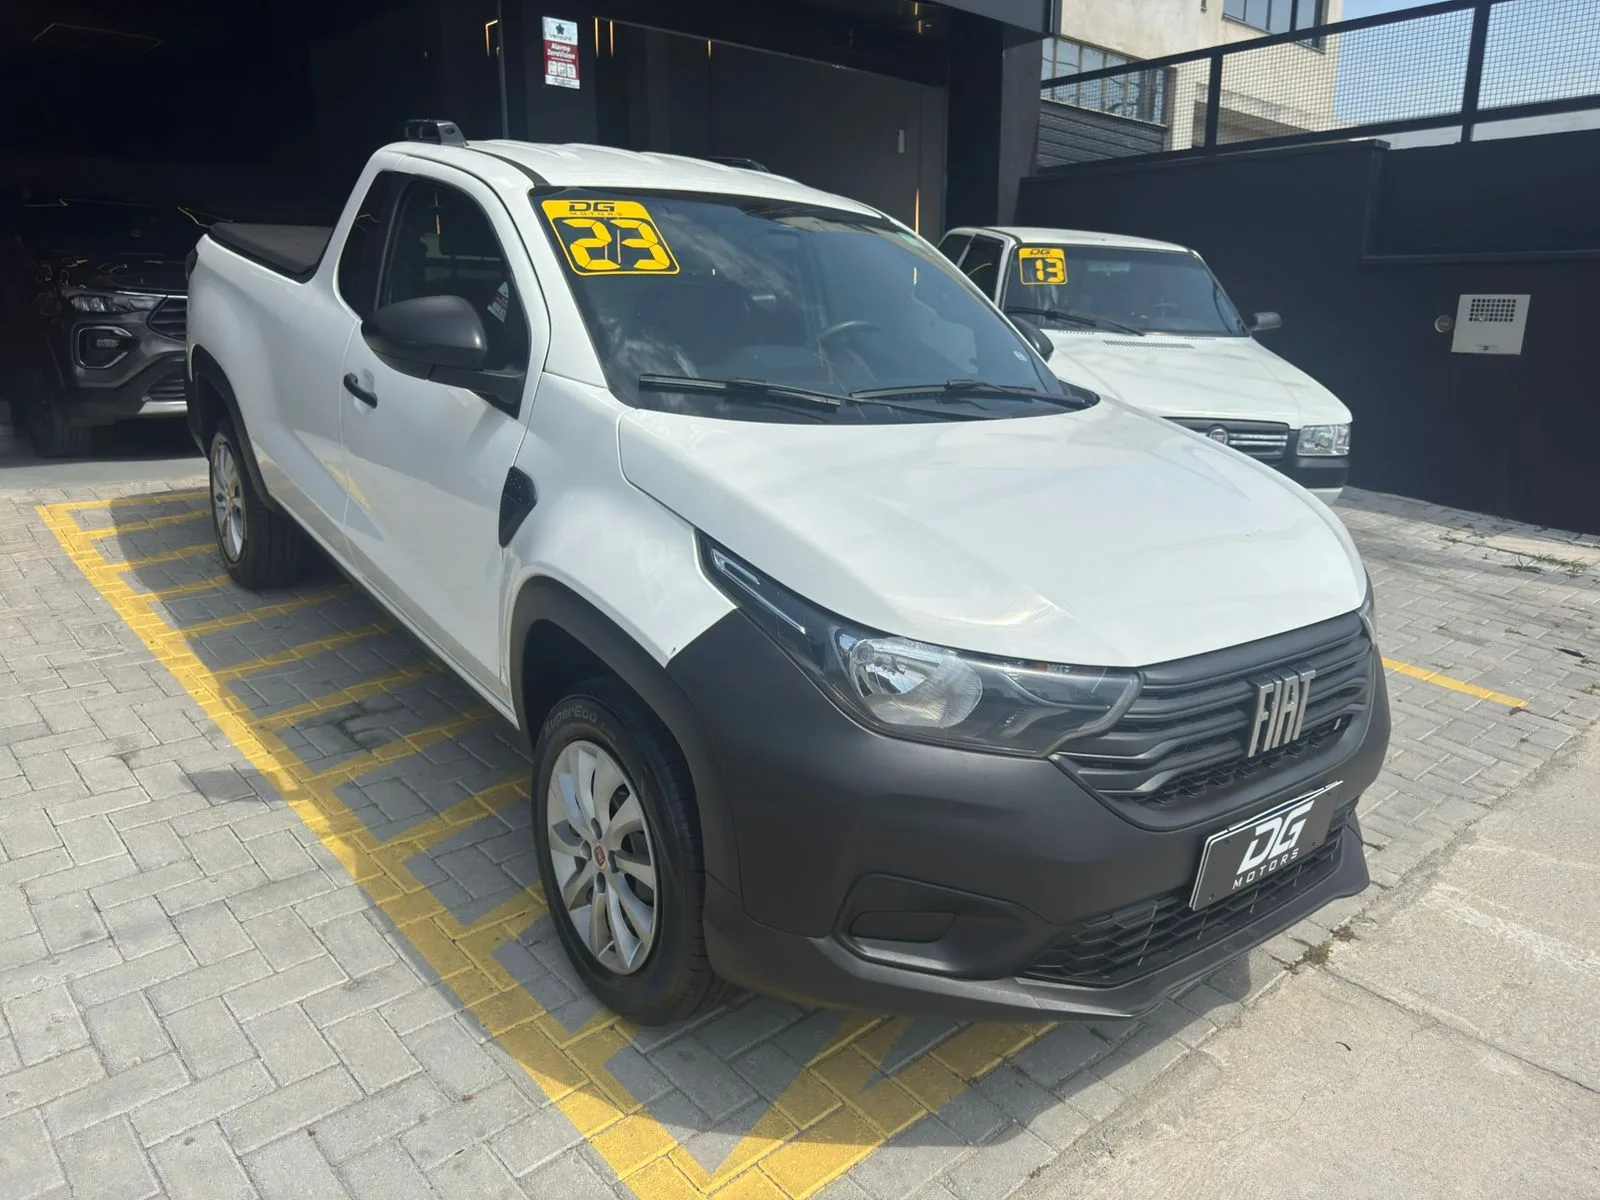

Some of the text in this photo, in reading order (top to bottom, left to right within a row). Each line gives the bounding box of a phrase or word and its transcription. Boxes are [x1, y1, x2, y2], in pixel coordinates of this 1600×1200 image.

[569, 201, 615, 212] DG
[562, 219, 670, 270] 23
[1035, 259, 1064, 283] 13
[1248, 669, 1316, 758] FIAT
[1236, 799, 1315, 875] DG
[1231, 847, 1299, 890] MOTORS
